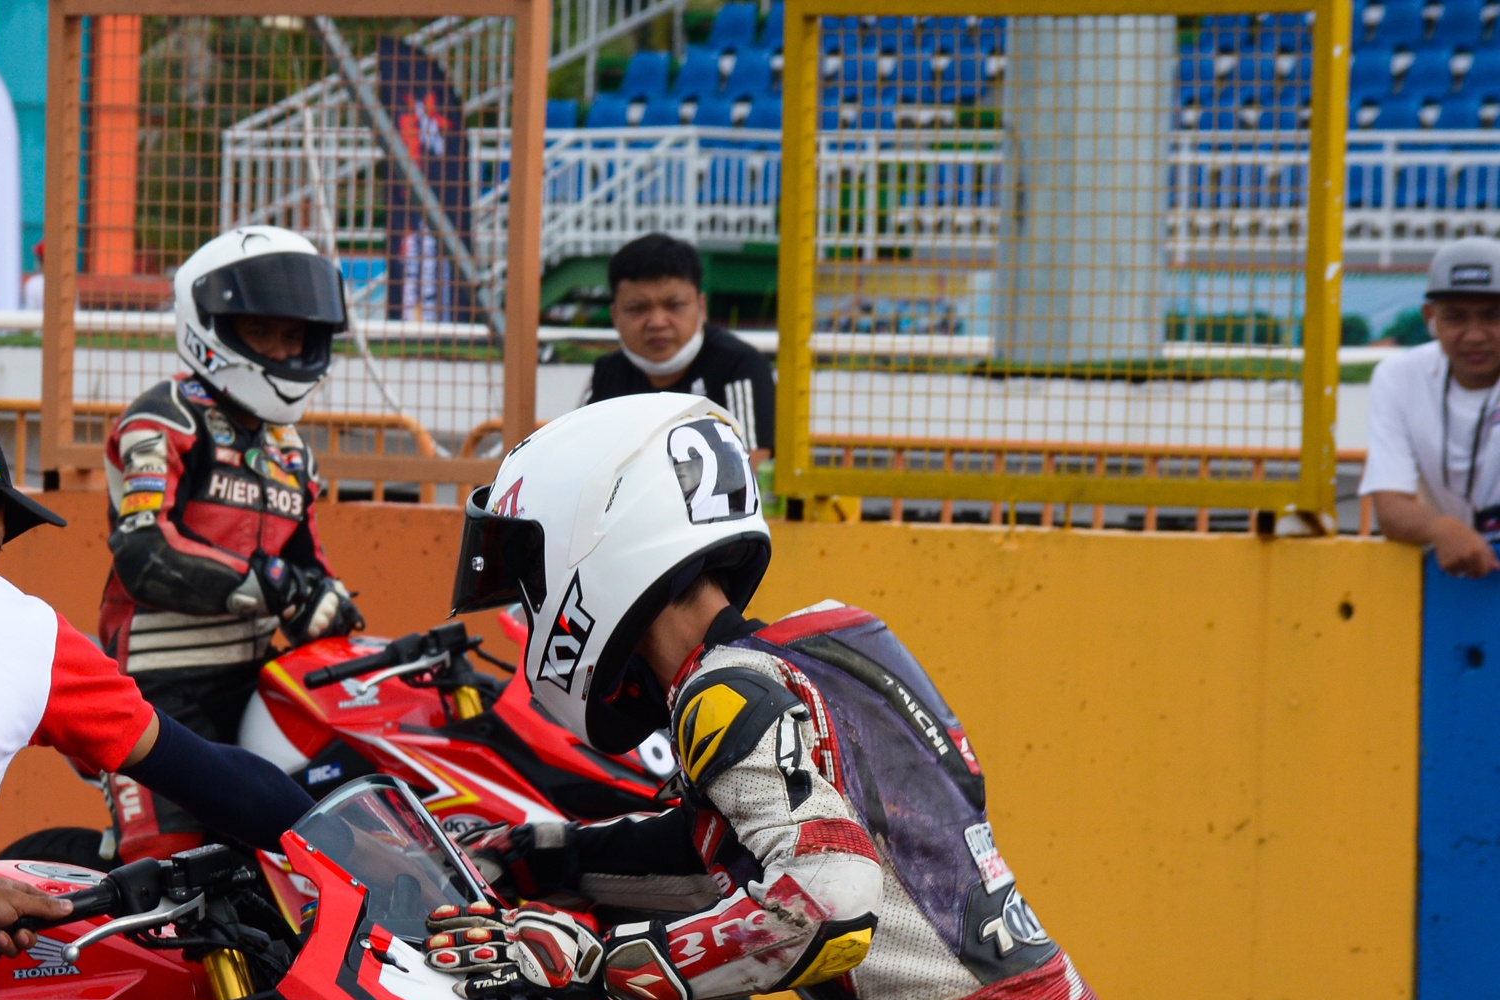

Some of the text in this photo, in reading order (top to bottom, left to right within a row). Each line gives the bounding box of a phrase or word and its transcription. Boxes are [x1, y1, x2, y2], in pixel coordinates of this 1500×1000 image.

[266, 487, 303, 516] 303
[537, 568, 595, 695] KYT
[13, 965, 81, 979] HONDA
